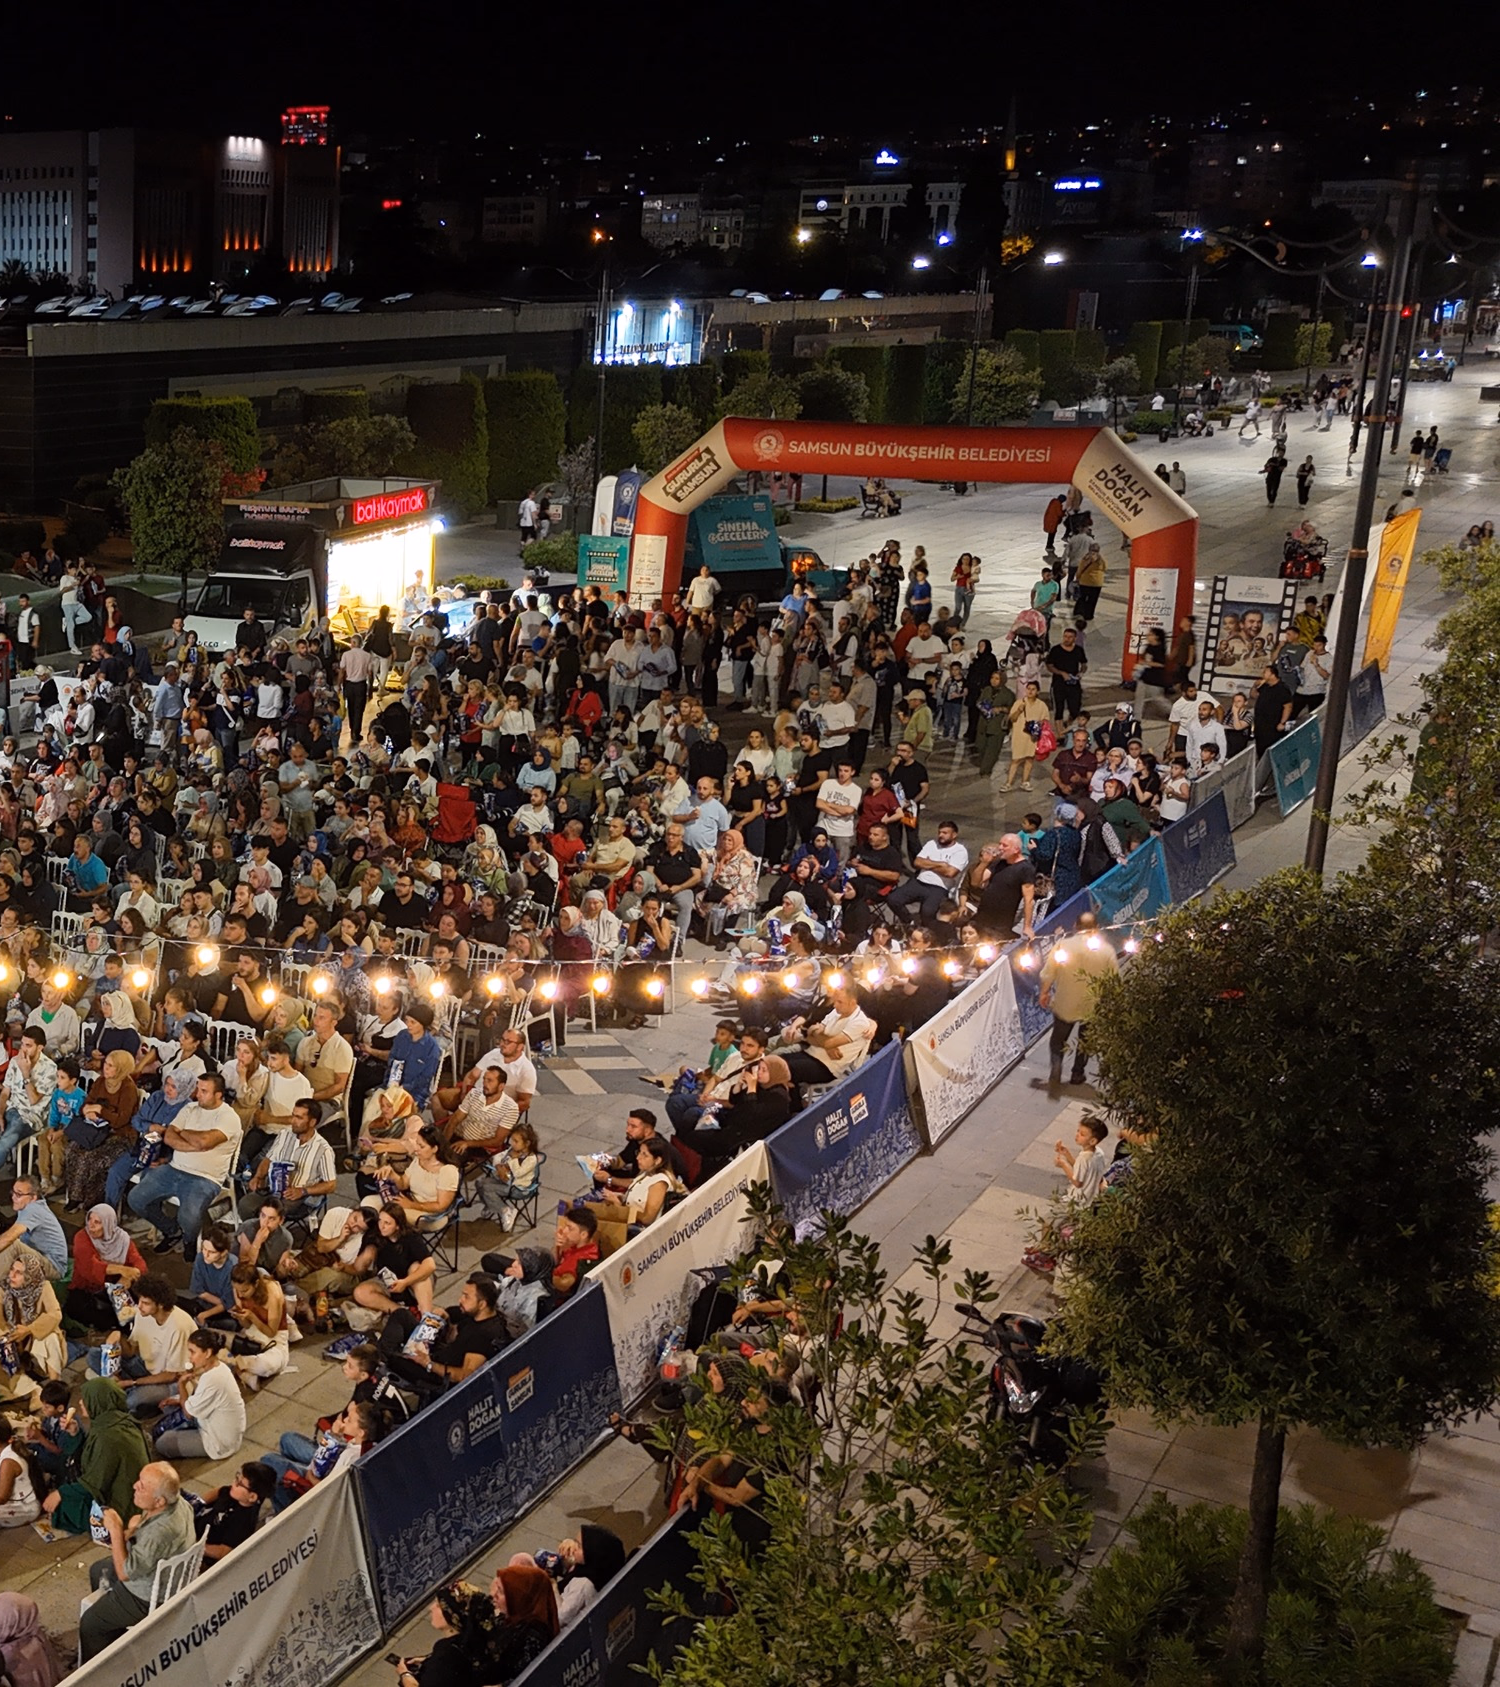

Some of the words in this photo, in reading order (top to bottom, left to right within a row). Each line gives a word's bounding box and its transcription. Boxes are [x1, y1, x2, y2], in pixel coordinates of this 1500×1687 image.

[788, 440, 851, 455] SAMSUN
[854, 442, 955, 461] BÜYÜKŞEHİR
[958, 445, 1051, 462] BELEDİYESİ
[665, 451, 711, 495] GURURLA
[676, 461, 718, 501] SAMSUN
[1094, 468, 1144, 518] DOĞAN
[717, 520, 759, 533] SİNEMA
[636, 1241, 669, 1276] SAMSUN
[668, 1206, 713, 1251] BÜYÜKŞEHİR
[385, 1384, 409, 1420] 7
[159, 1591, 249, 1672] BÜYÜKŞEHİR
[248, 1527, 320, 1600] BELEDİYESİ
